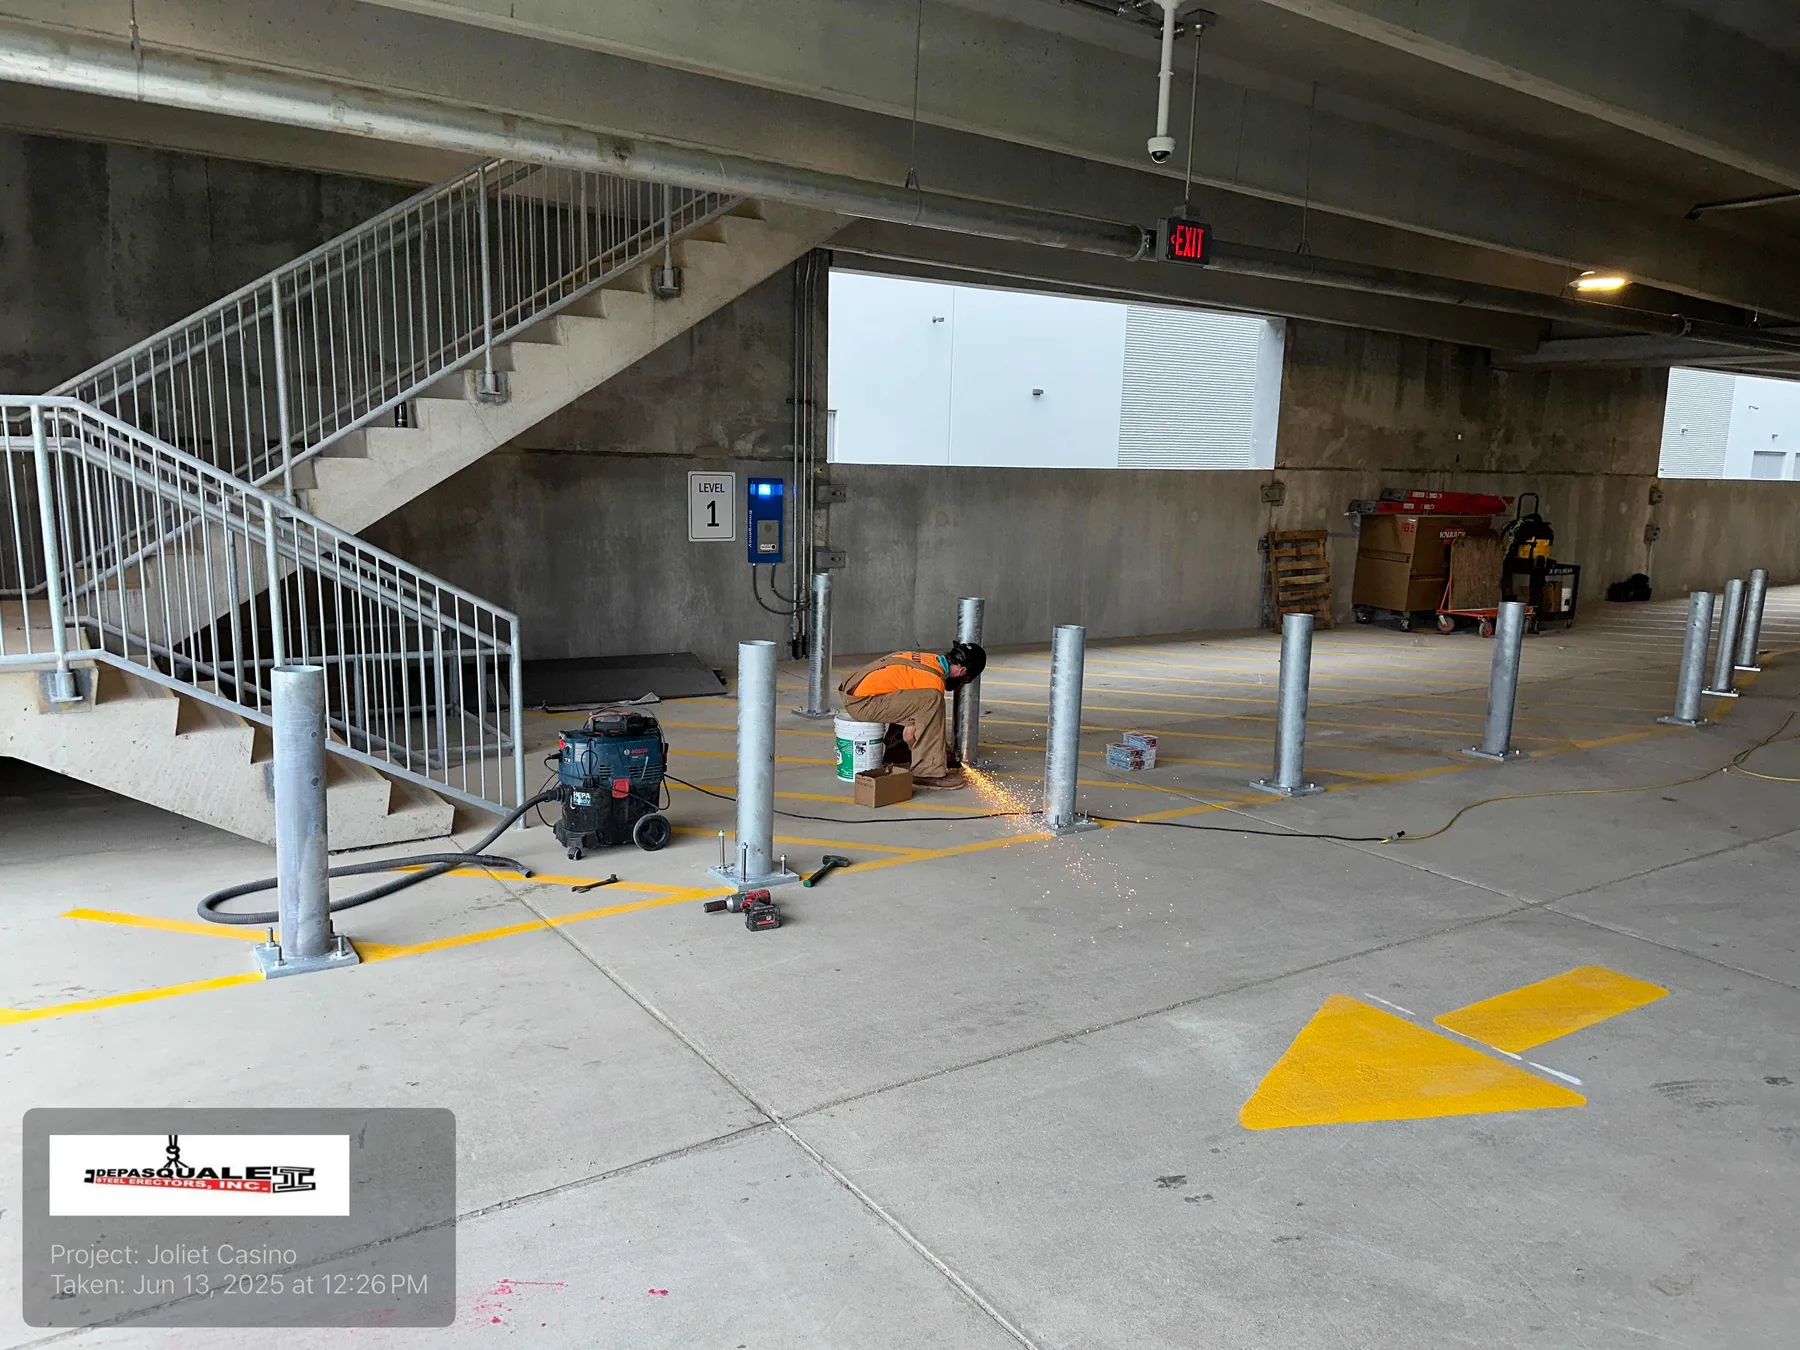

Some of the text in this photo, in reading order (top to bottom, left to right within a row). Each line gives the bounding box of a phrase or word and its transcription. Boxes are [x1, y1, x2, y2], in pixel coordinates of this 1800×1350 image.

[1175, 224, 1205, 258] EXIT
[699, 483, 725, 493] LEVEL
[706, 500, 720, 527] 1
